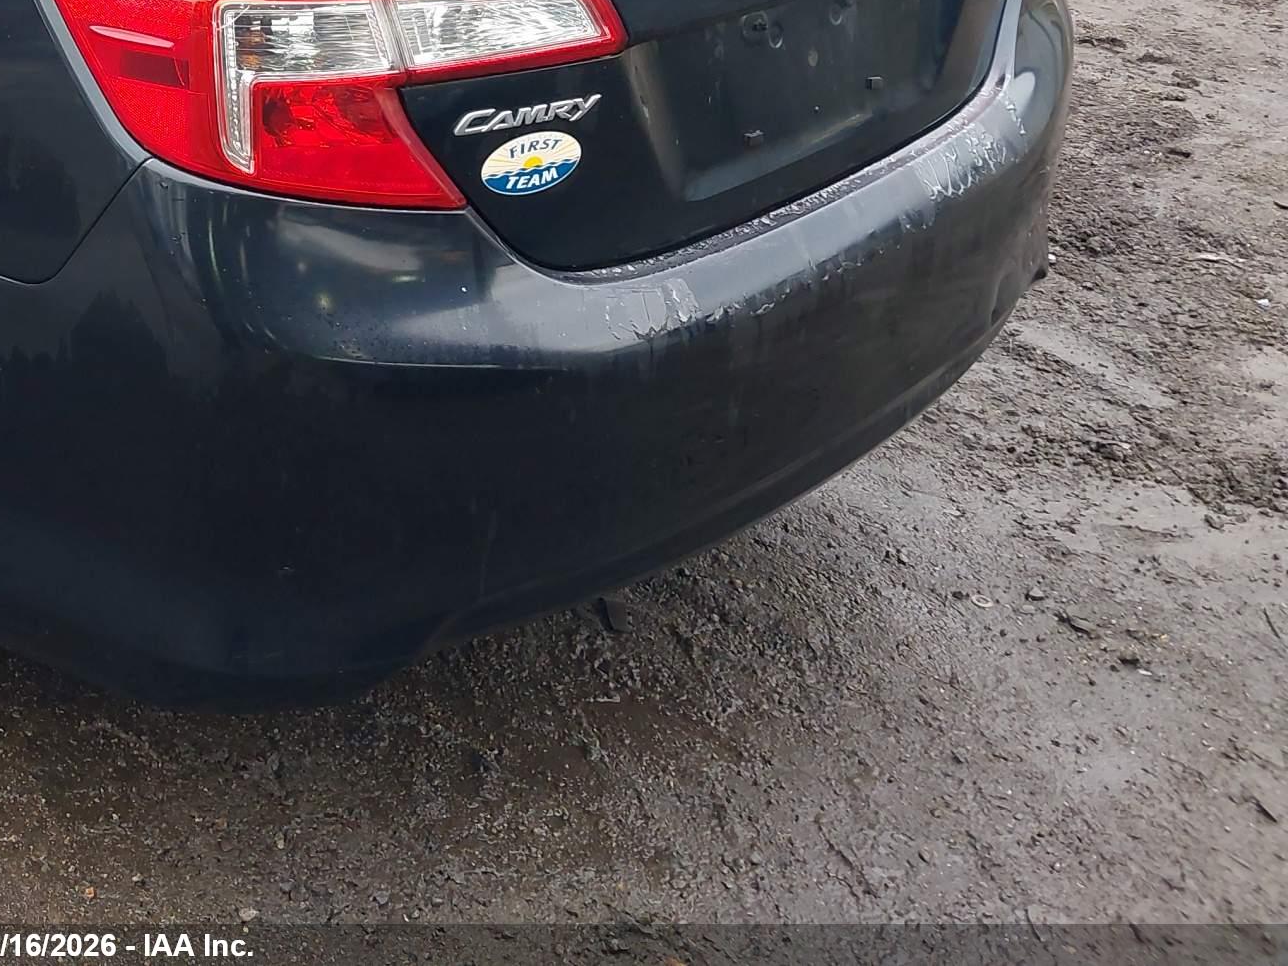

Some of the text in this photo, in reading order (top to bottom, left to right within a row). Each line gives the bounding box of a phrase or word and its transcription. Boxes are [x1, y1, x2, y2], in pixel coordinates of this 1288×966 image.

[453, 94, 602, 136] CAMRY
[509, 138, 563, 159] FIRST
[506, 167, 559, 189] TEAM
